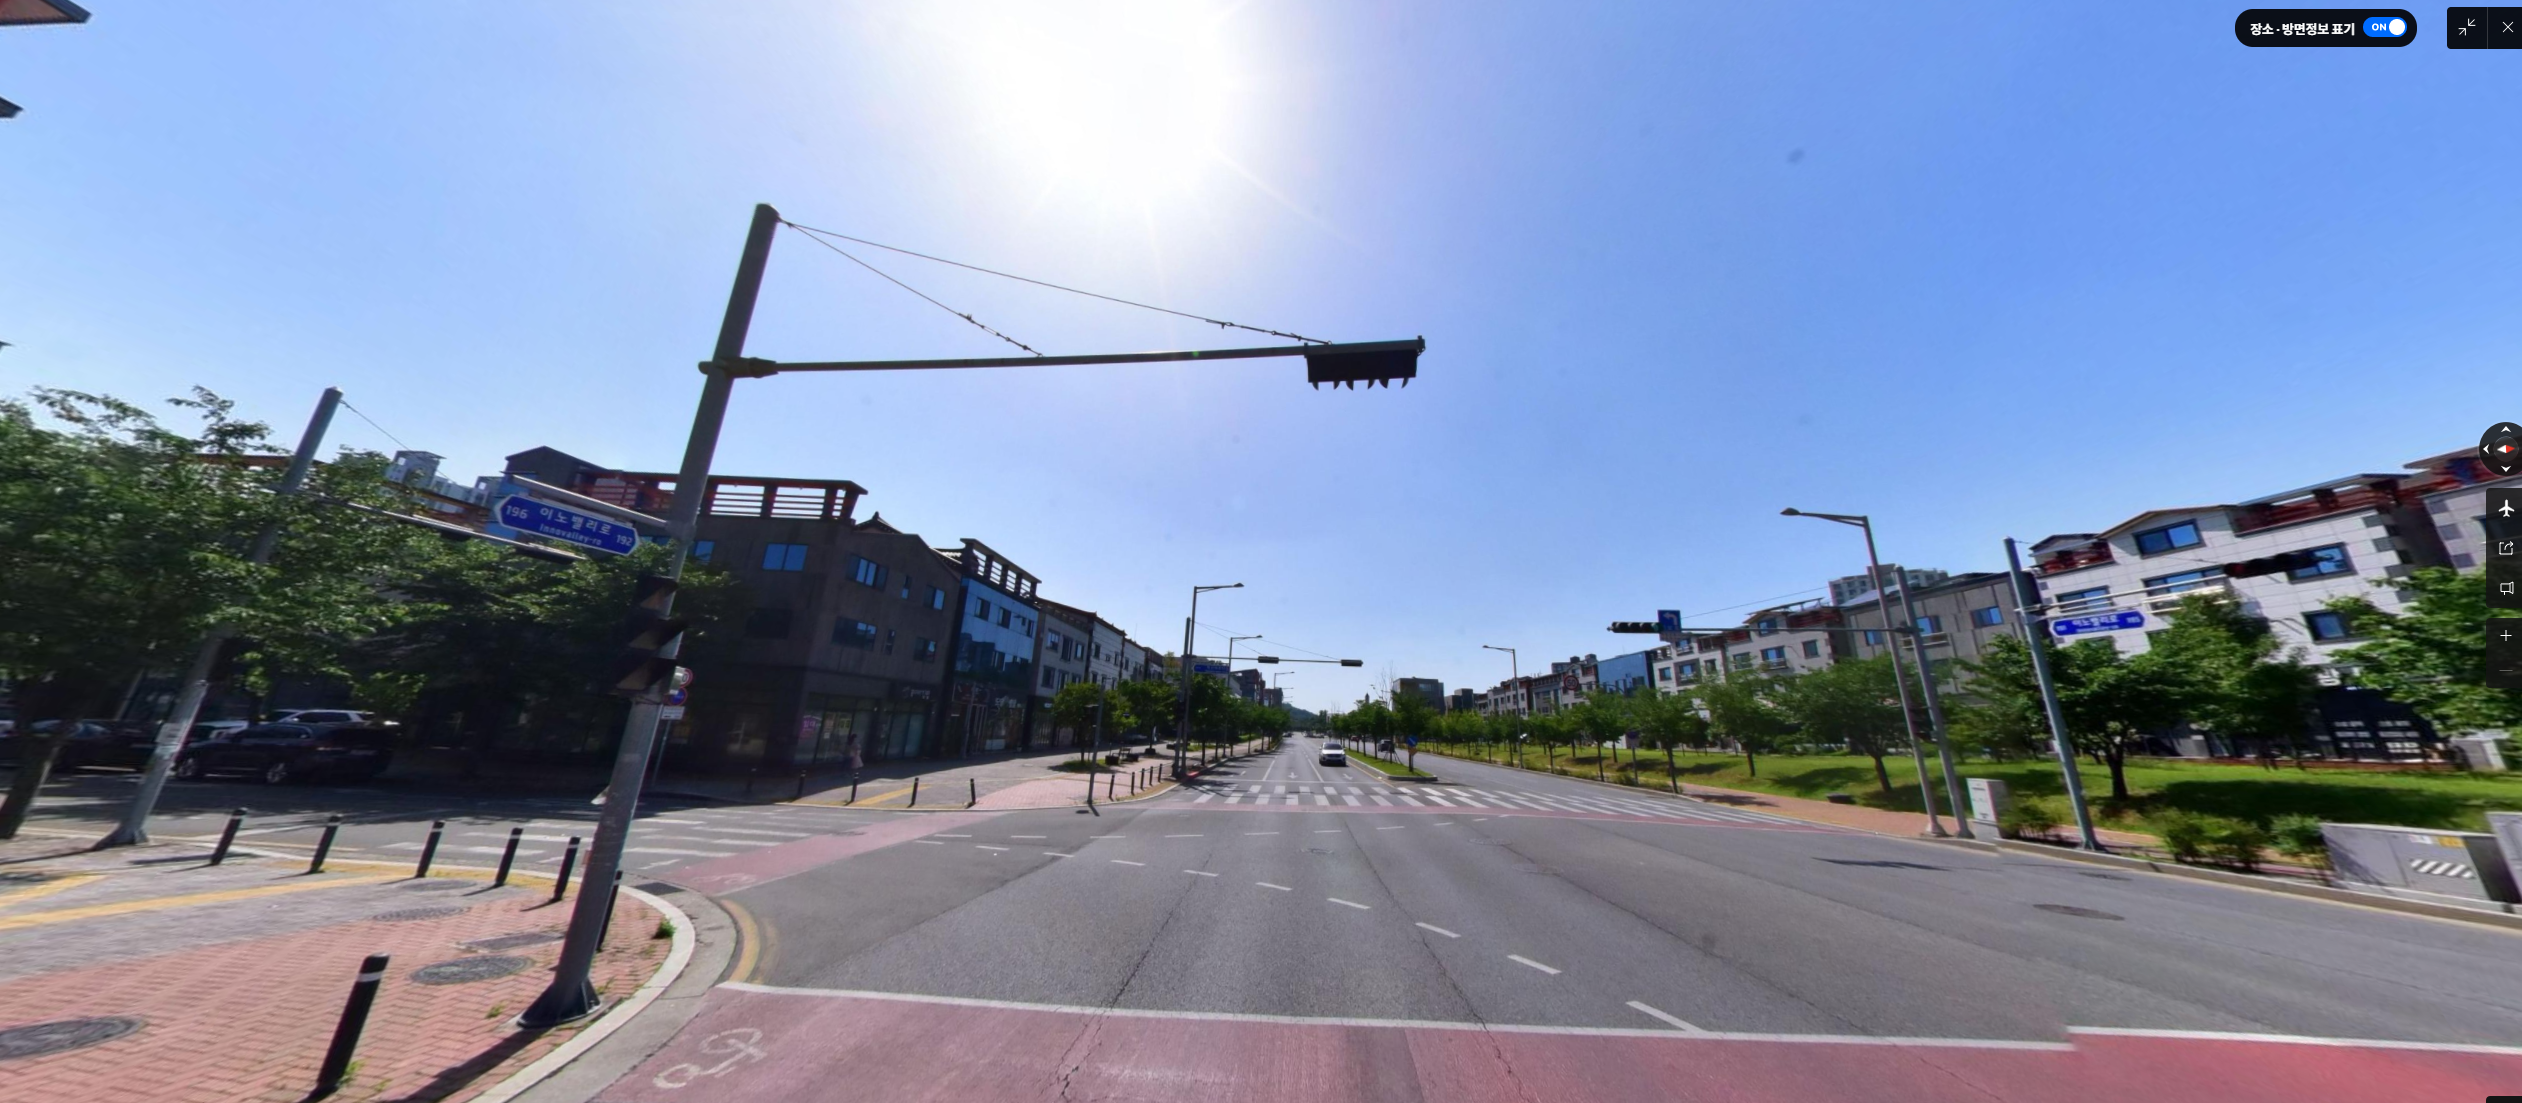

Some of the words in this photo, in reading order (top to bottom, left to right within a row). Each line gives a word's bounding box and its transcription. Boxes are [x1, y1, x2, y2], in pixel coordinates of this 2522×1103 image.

[505, 505, 529, 520] 196
[540, 508, 612, 536] 이노밸리로
[539, 523, 603, 546] Innovalley-ro
[616, 534, 633, 547] 192
